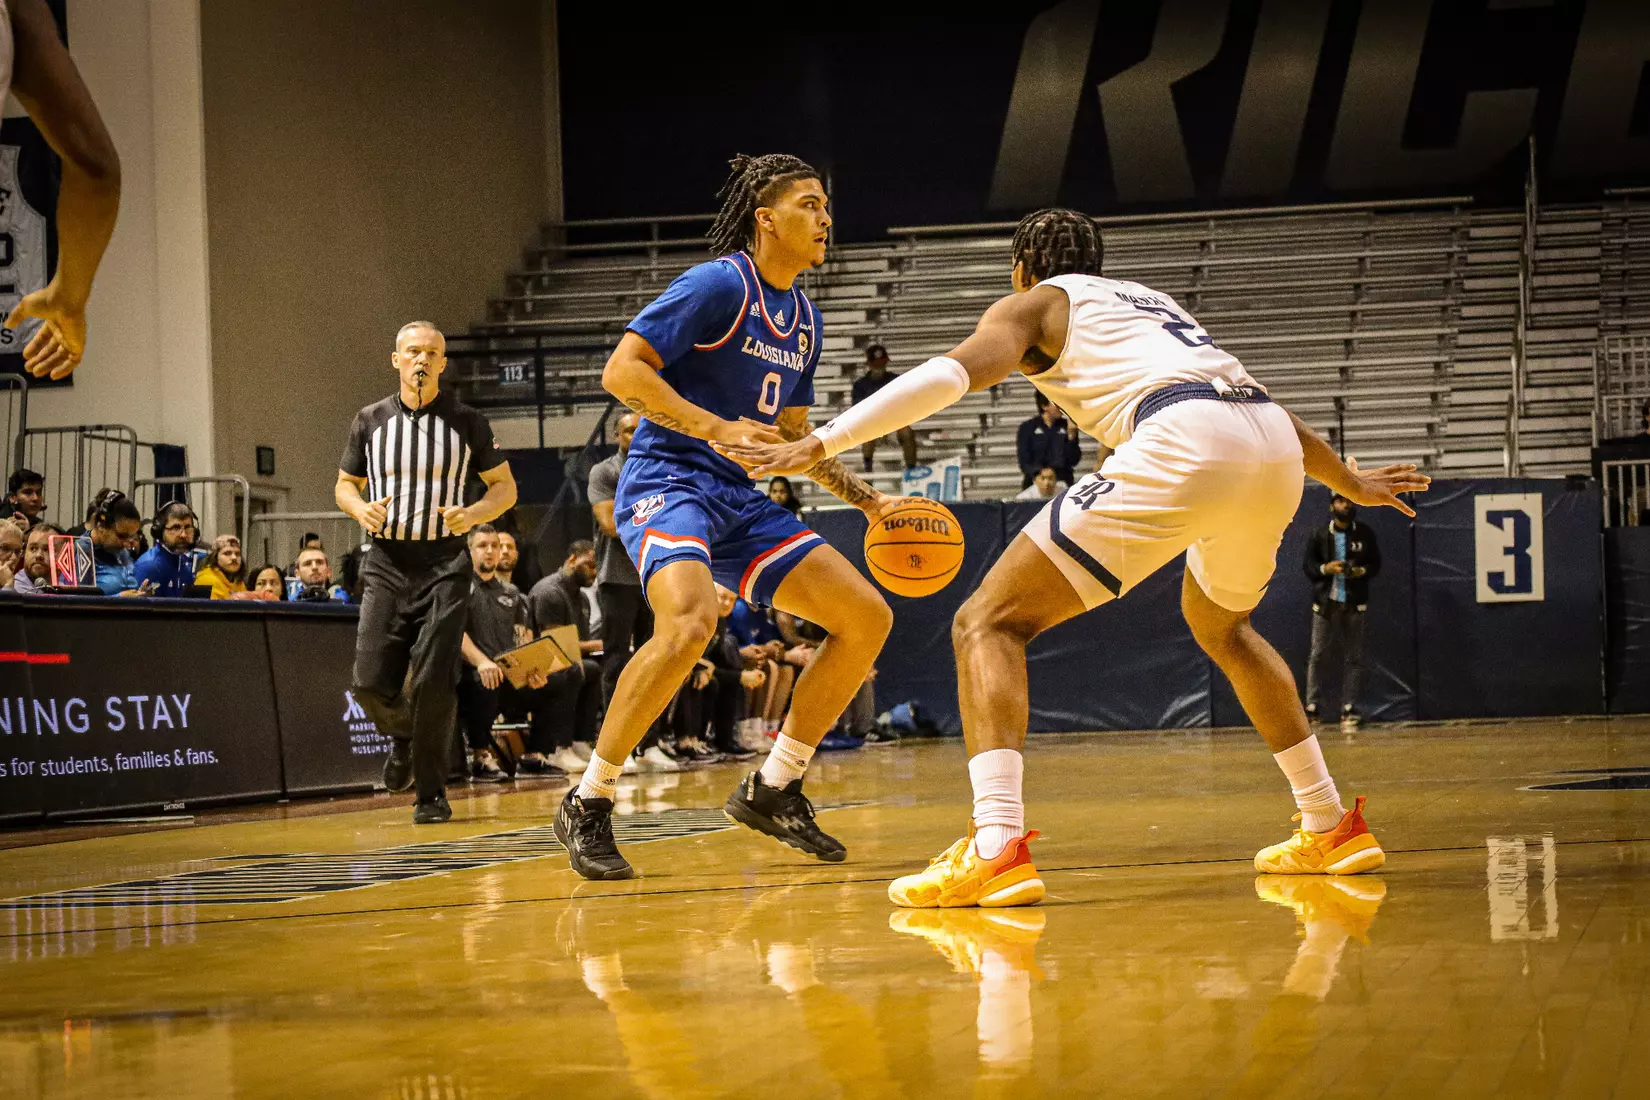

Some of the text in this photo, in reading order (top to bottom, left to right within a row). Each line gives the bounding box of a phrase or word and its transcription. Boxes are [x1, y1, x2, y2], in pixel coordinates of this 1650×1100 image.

[1134, 304, 1221, 349] 2
[741, 336, 804, 372] LOUISIANA
[503, 366, 523, 380] 113
[757, 371, 781, 416] 0
[883, 517, 950, 536] Wilson
[1486, 509, 1533, 595] 3
[106, 693, 191, 731] STAY
[11, 757, 36, 776] for
[40, 756, 113, 777] students,
[115, 750, 171, 770] families
[174, 749, 185, 766] &
[186, 748, 219, 765] fans.
